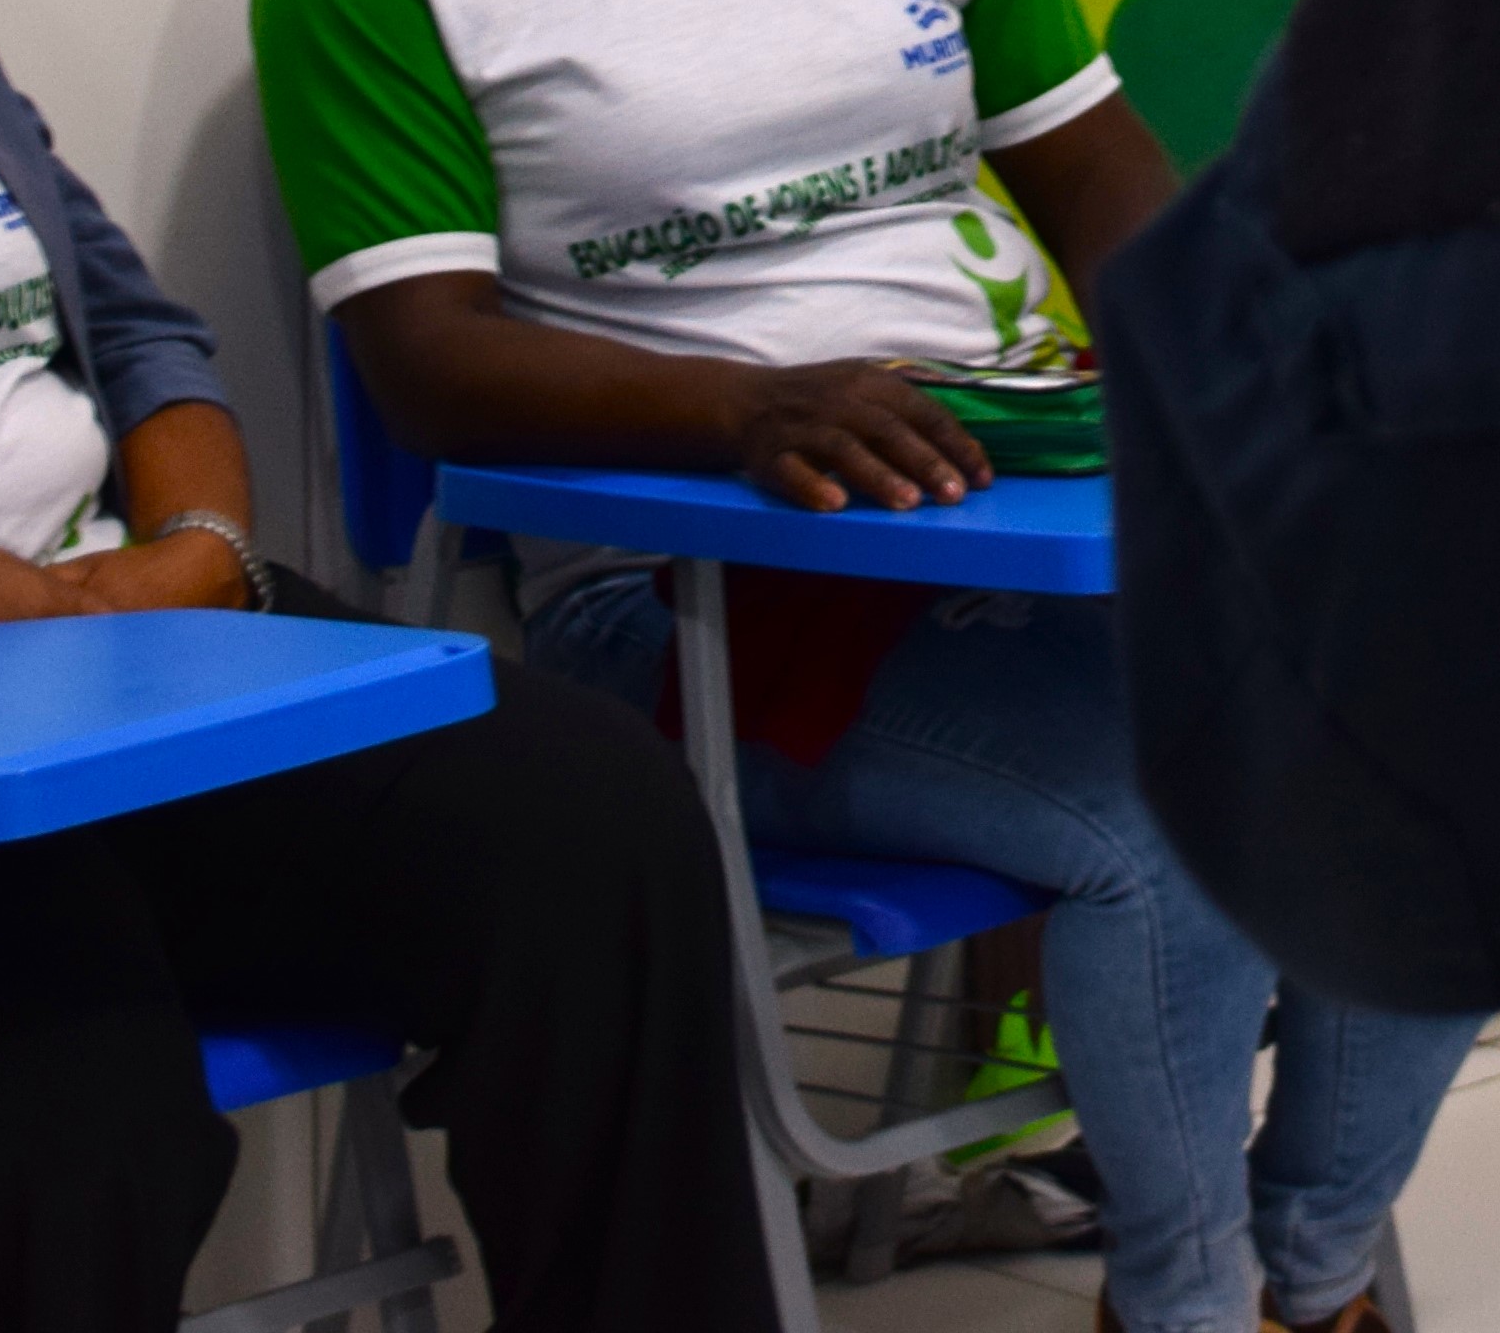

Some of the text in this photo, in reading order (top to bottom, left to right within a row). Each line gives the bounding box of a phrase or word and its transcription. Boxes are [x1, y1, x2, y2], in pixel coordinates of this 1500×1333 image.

[723, 194, 766, 237] DE
[766, 164, 859, 221] JOVENS
[863, 156, 878, 197] E
